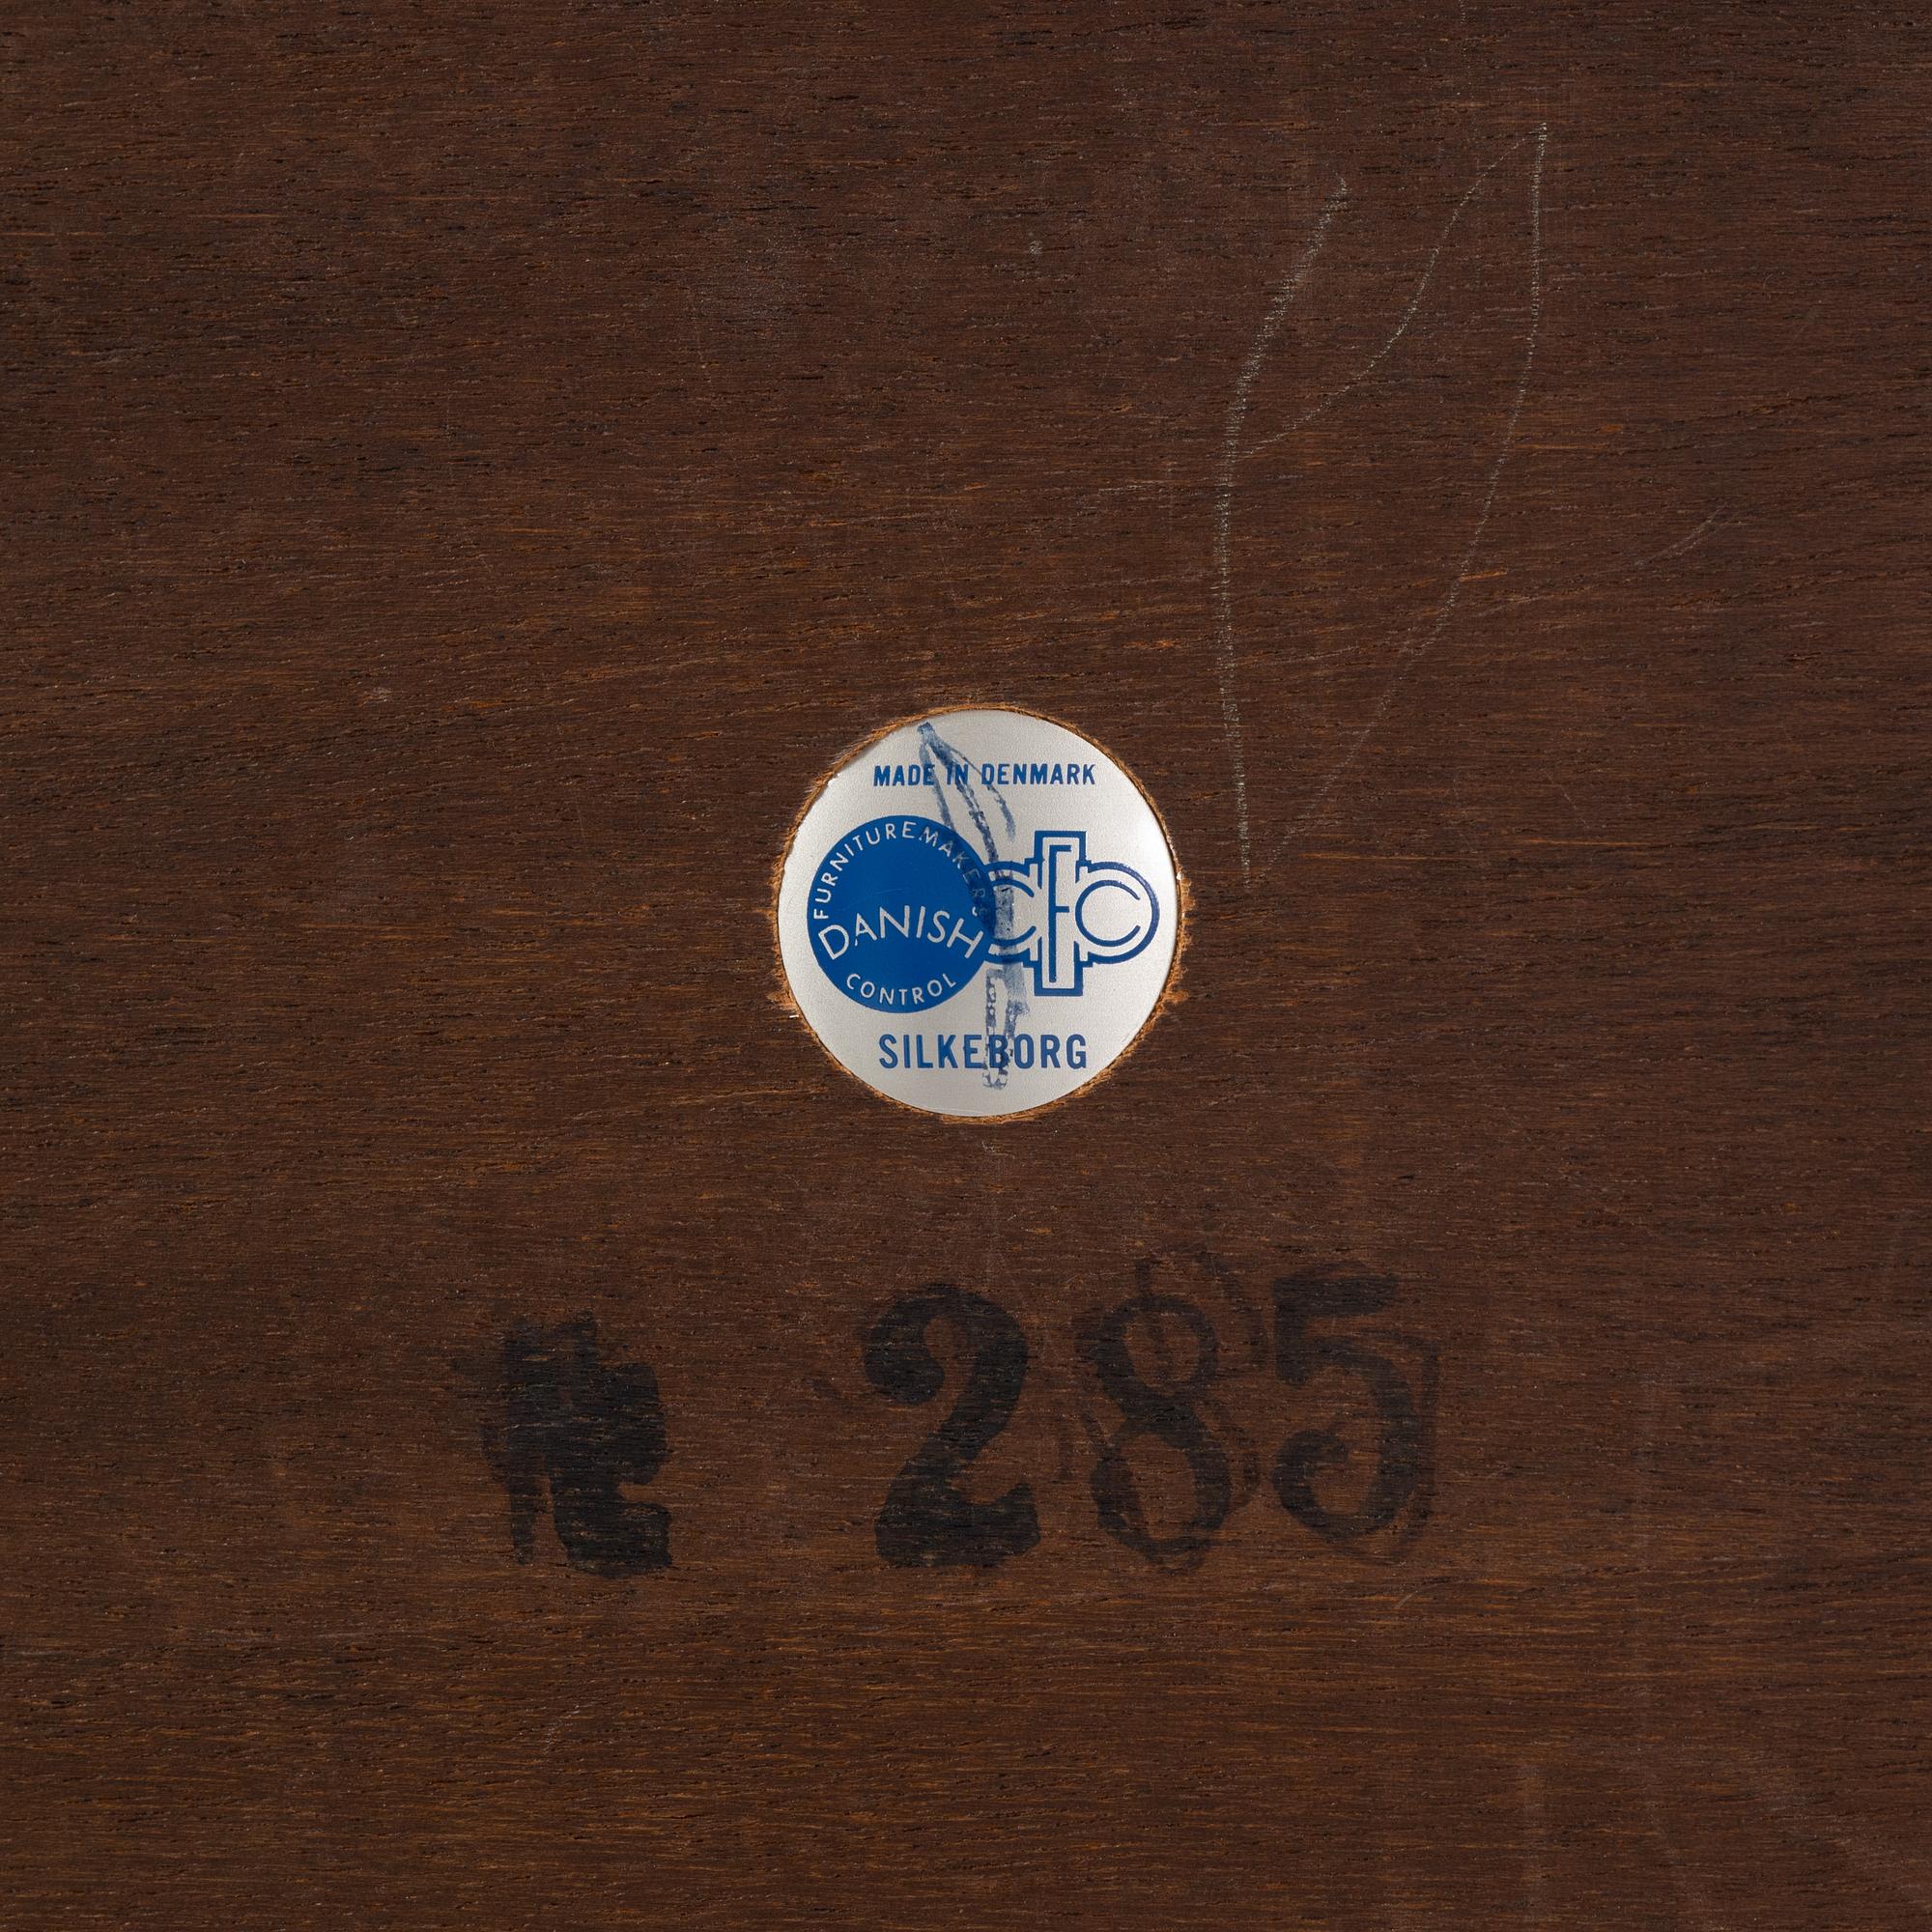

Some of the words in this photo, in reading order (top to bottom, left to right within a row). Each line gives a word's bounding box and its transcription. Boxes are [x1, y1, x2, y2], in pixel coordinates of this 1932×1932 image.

[873, 764, 934, 785] MADE
[946, 764, 969, 784] IN
[980, 763, 1095, 785] DENMARK
[818, 904, 983, 960] DANISH
[846, 972, 957, 1007] CONTROL
[879, 1033, 1087, 1069] SILKEBORG
[864, 1263, 1432, 1570] 285
